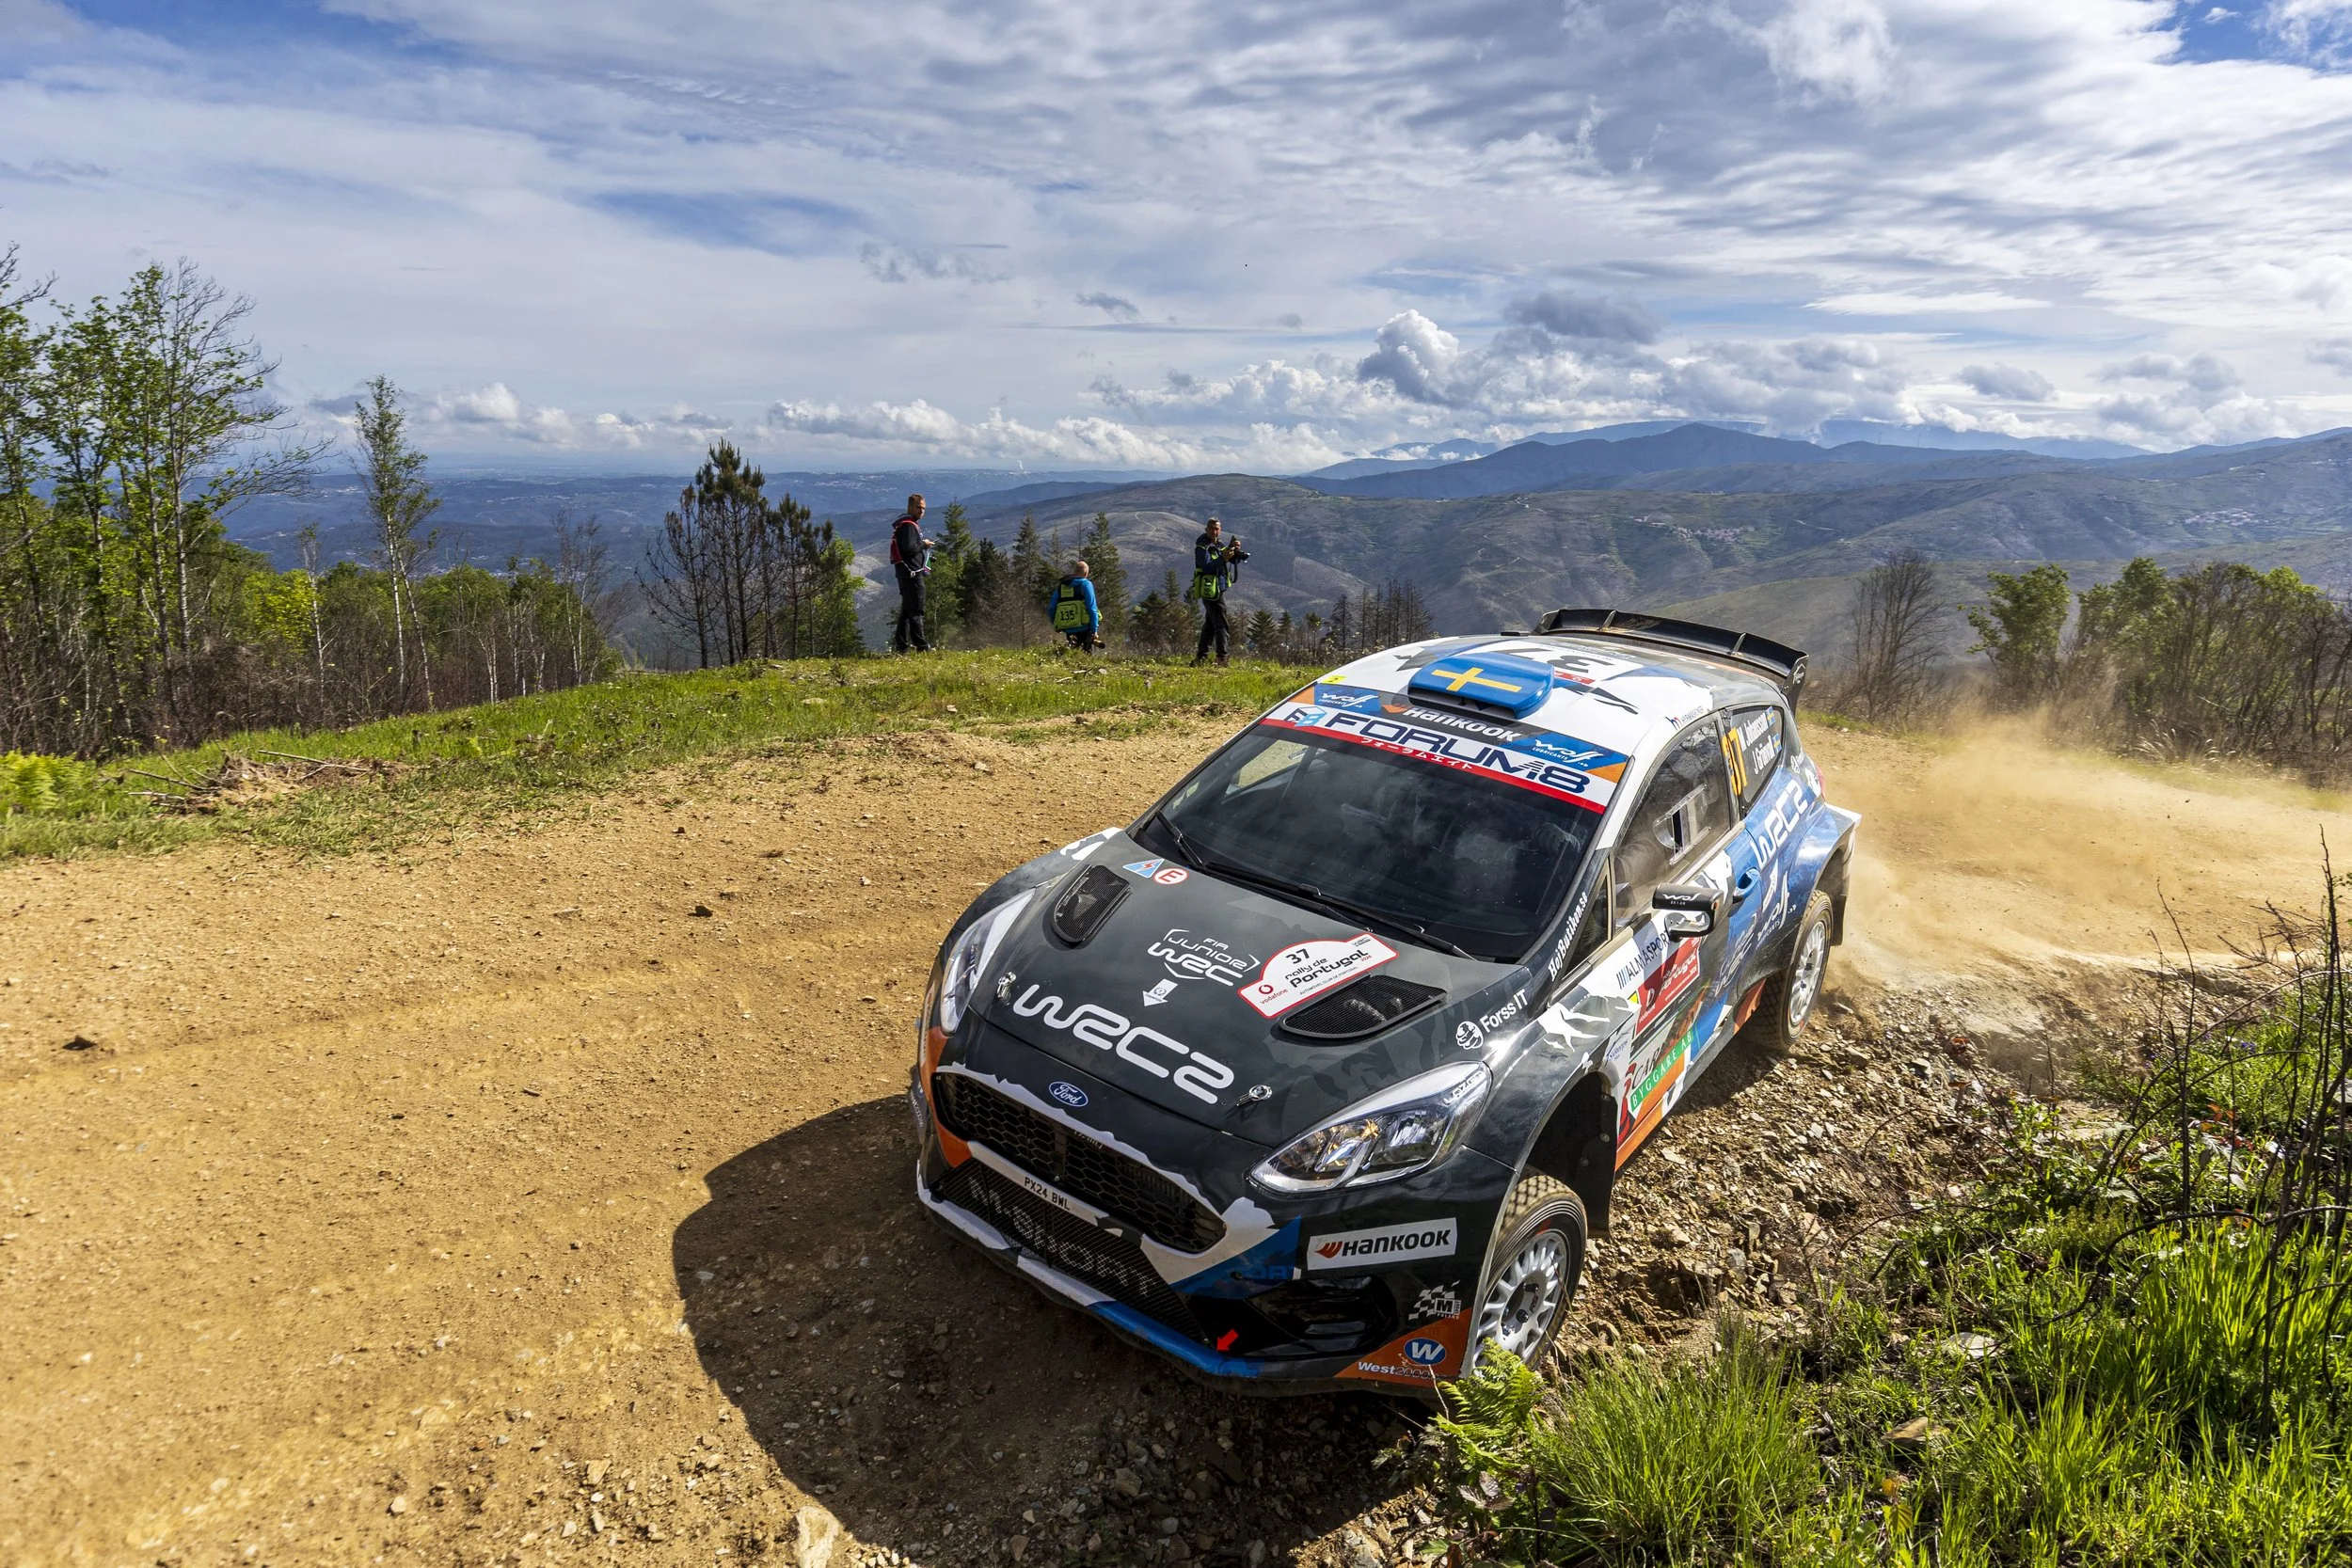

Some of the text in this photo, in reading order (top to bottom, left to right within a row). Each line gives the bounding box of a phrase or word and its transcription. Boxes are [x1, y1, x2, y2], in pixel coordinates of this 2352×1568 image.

[1059, 610, 1075, 621] 135
[1325, 712, 1591, 794] FORUM8
[1749, 779, 1808, 871] WRC2
[1158, 869, 1184, 883] E
[1168, 937, 1248, 971] JUNIOR
[1203, 938, 1230, 951] FIA
[1285, 947, 1311, 965] 37
[1147, 942, 1244, 987] WRC
[1285, 958, 1328, 981] rally de
[1289, 949, 1370, 989] Portugal
[1259, 988, 1289, 1005] vodafone
[1479, 988, 1529, 1033] Forss IT
[1012, 984, 1235, 1105] WRC2
[1631, 1050, 1677, 1108] BYGGARE
[1681, 1030, 1692, 1051] AB
[1053, 1083, 1081, 1104] Ford
[1024, 1176, 1071, 1212] PX24 BWL
[1412, 1341, 1444, 1361] W
